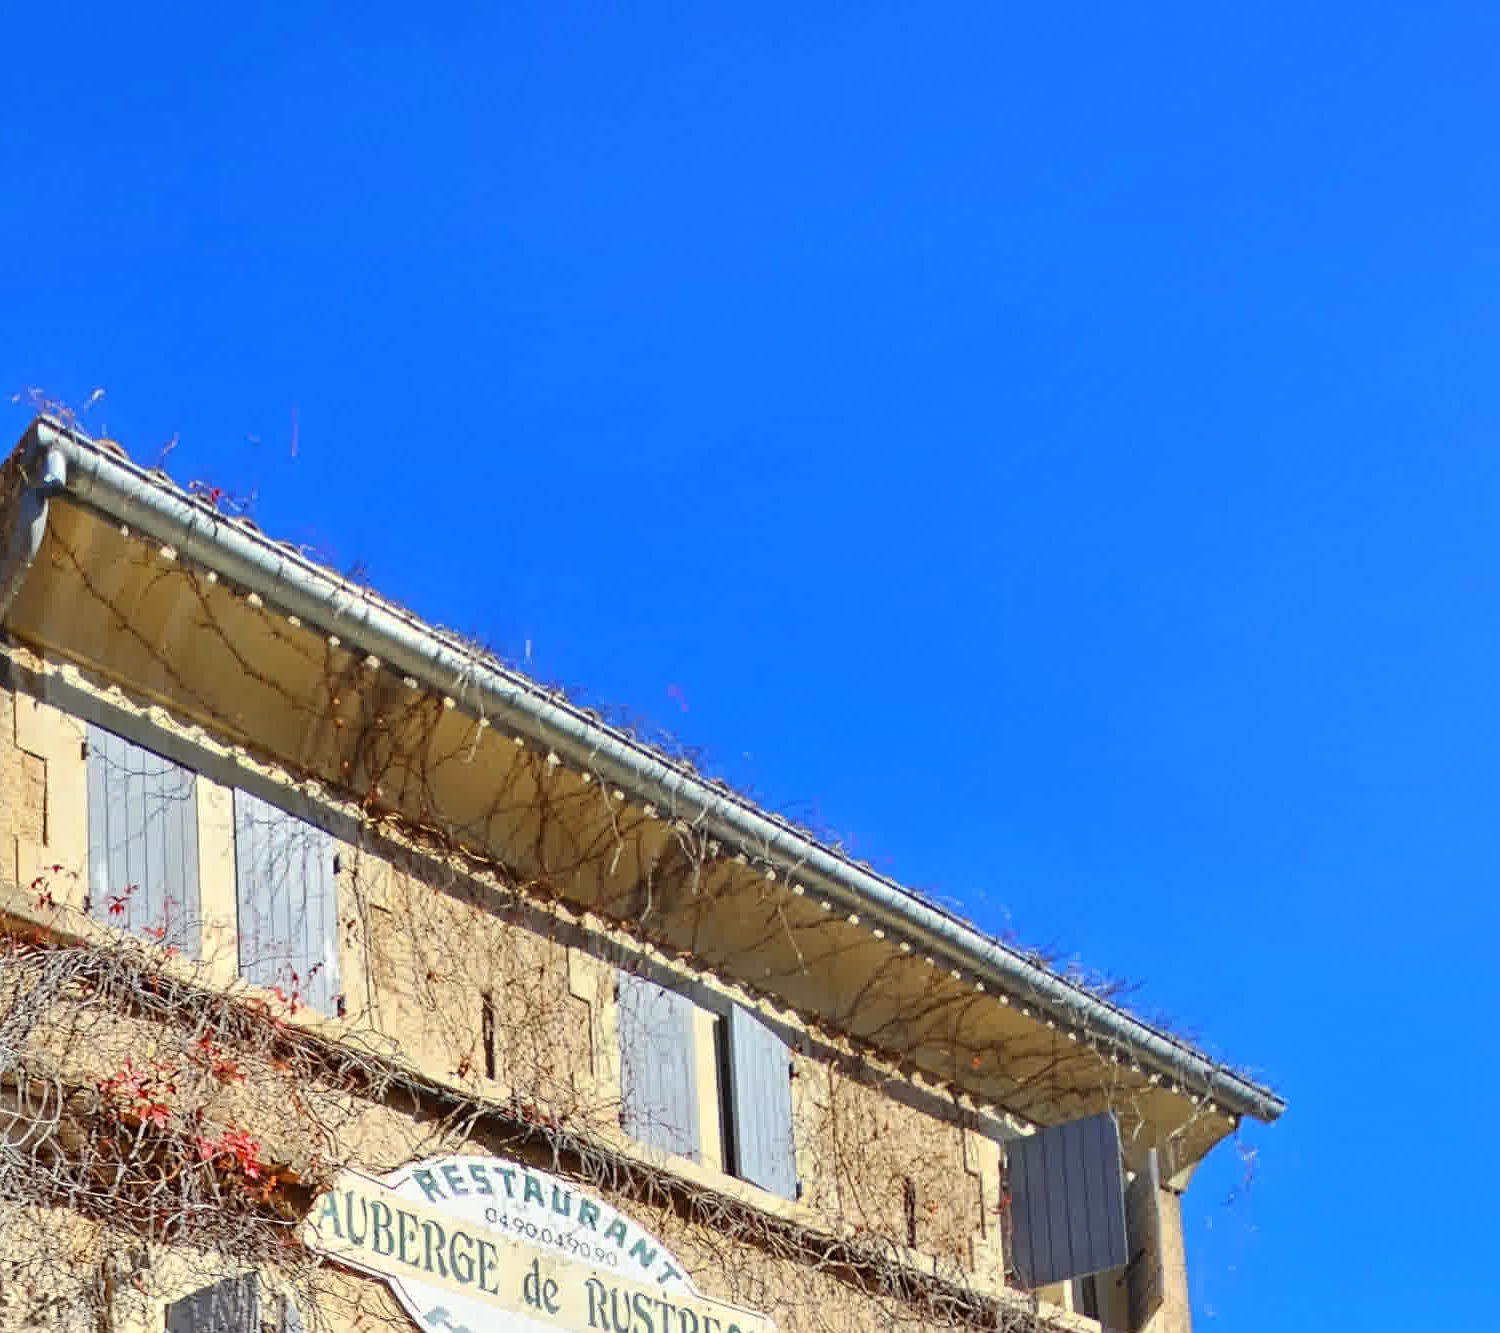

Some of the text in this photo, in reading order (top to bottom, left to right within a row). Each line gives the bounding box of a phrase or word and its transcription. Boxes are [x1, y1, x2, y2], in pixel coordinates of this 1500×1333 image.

[317, 1190, 500, 1296] AUBERGE
[523, 1256, 560, 1315] de
[412, 1164, 683, 1284] RESTAURANT
